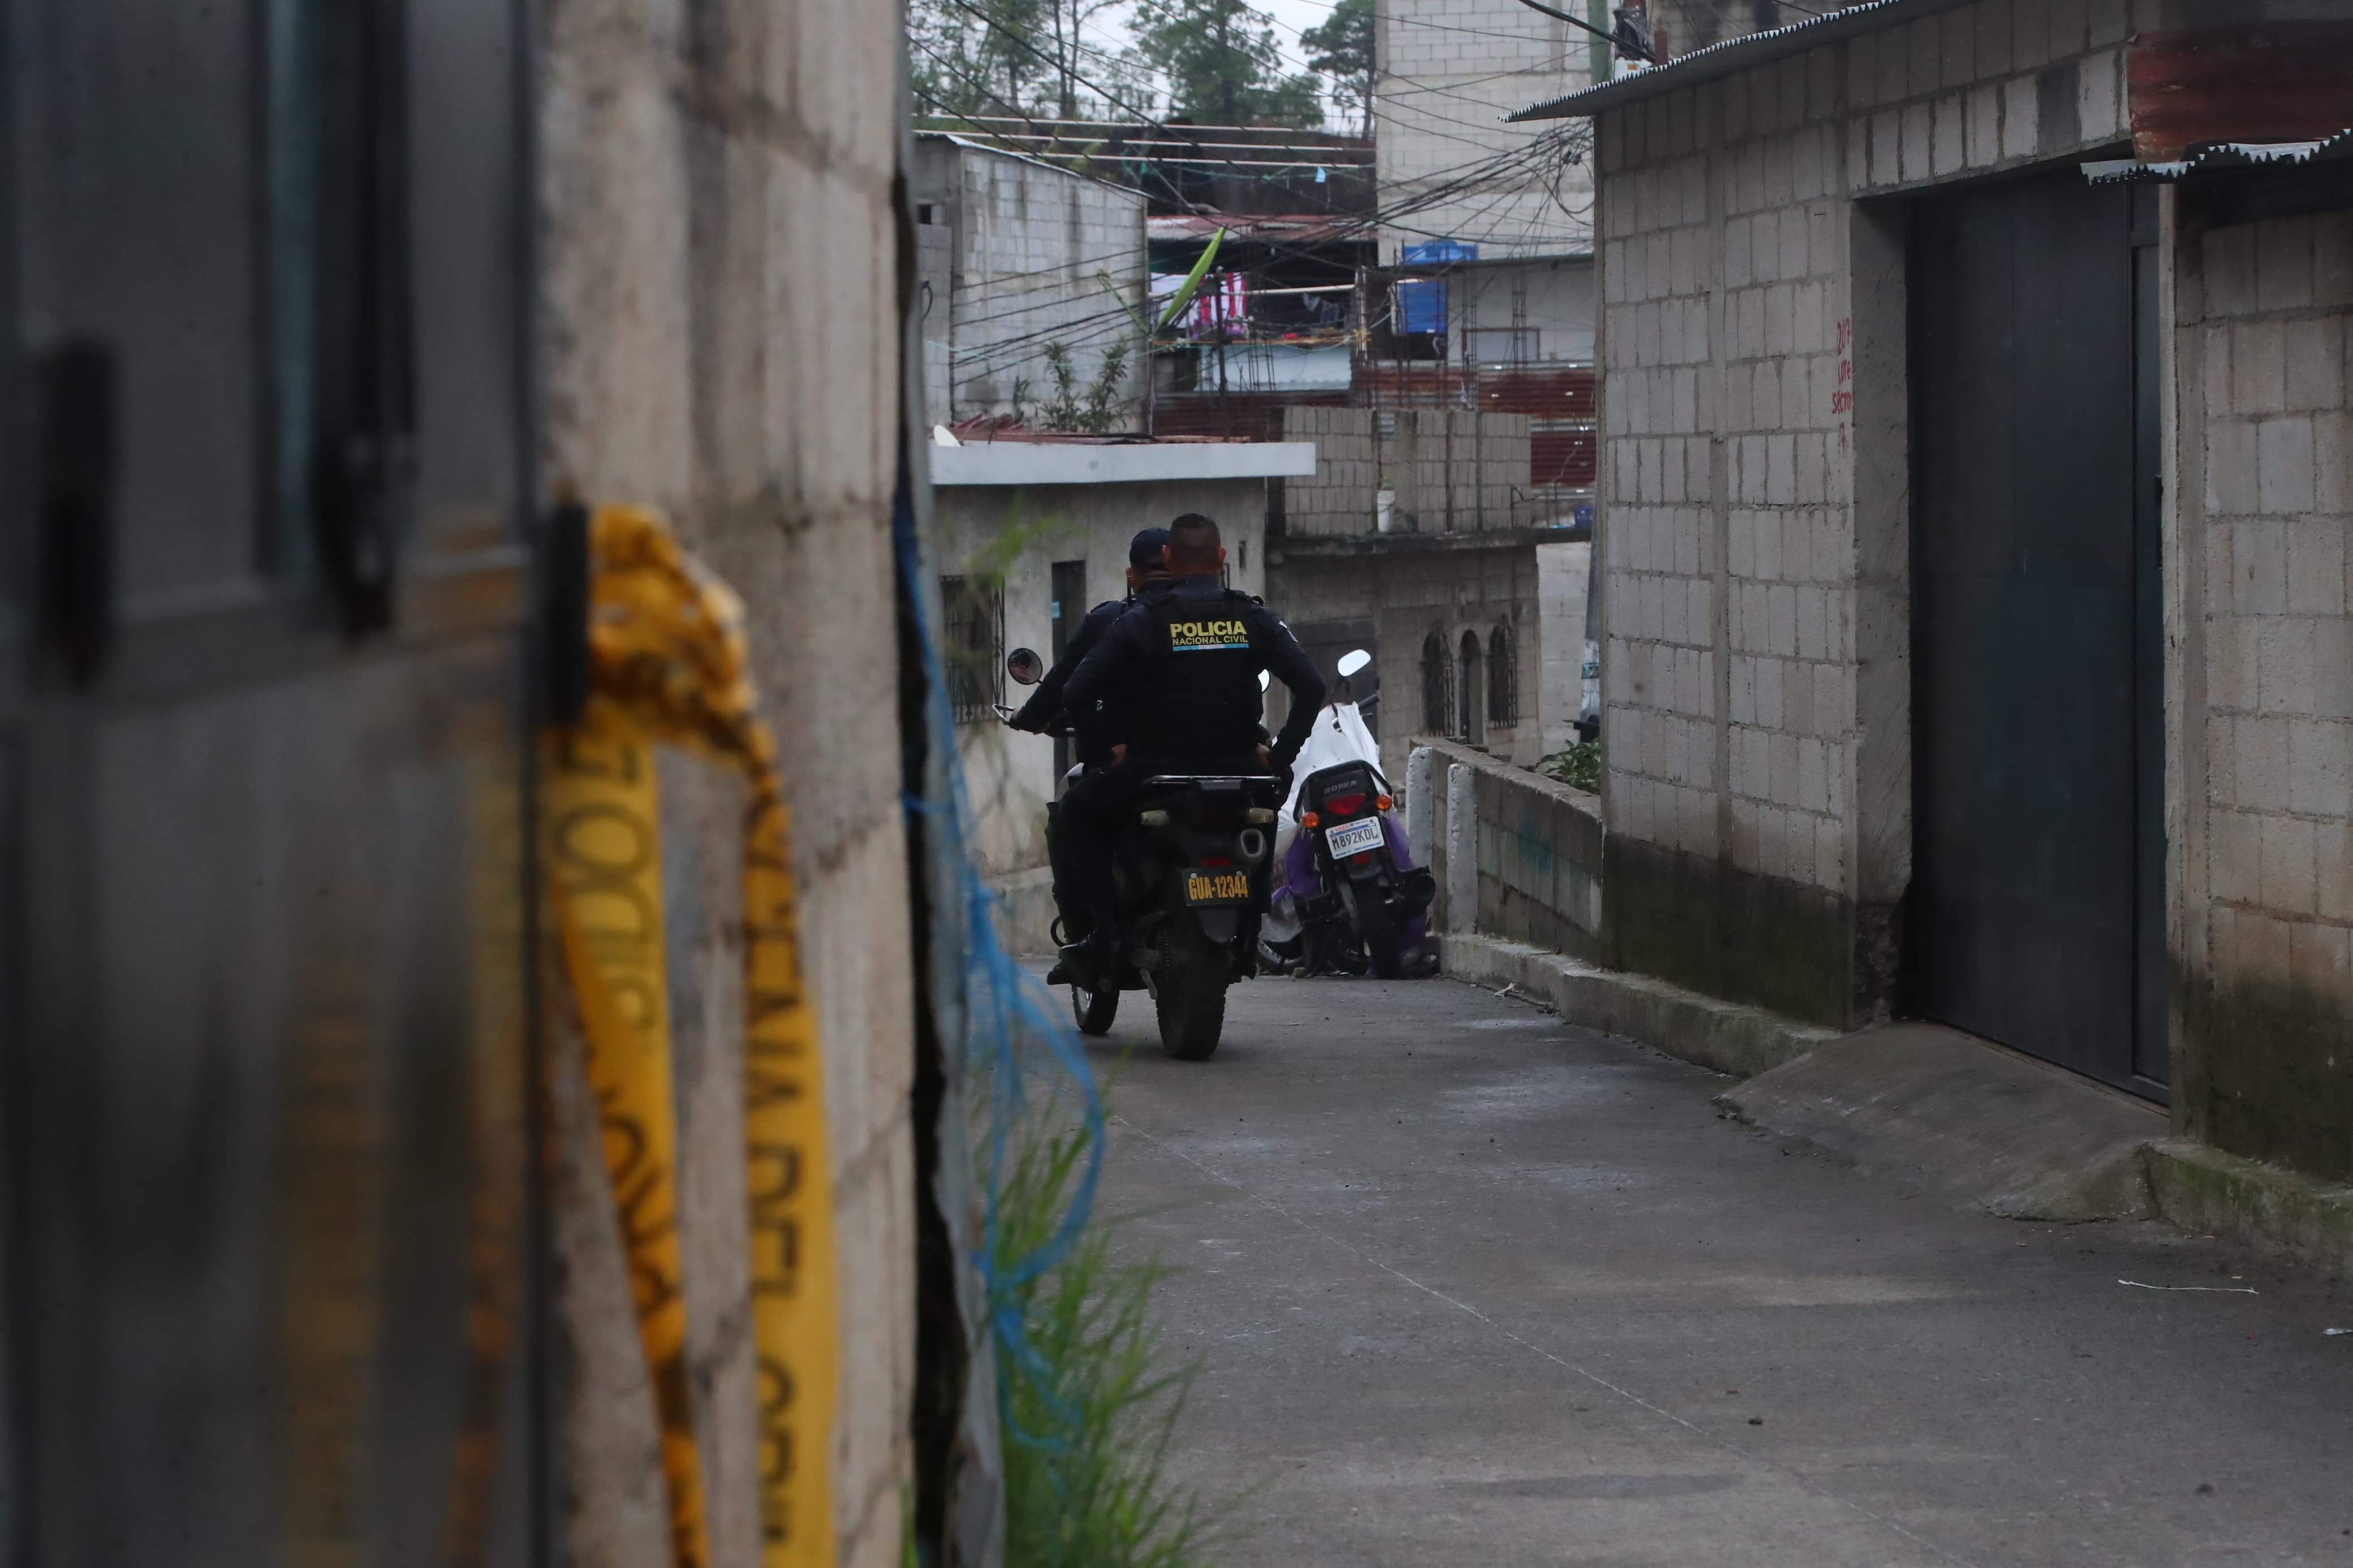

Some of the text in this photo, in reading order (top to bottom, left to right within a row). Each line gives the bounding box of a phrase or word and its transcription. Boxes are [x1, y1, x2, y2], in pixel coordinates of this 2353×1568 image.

[1170, 621, 1247, 637] POLICIA
[1173, 636, 1222, 646] NACIONAL
[1324, 780, 1358, 794] BOXER
[1331, 827, 1378, 850] M892KDL
[1188, 875, 1248, 900] GUA-12344
